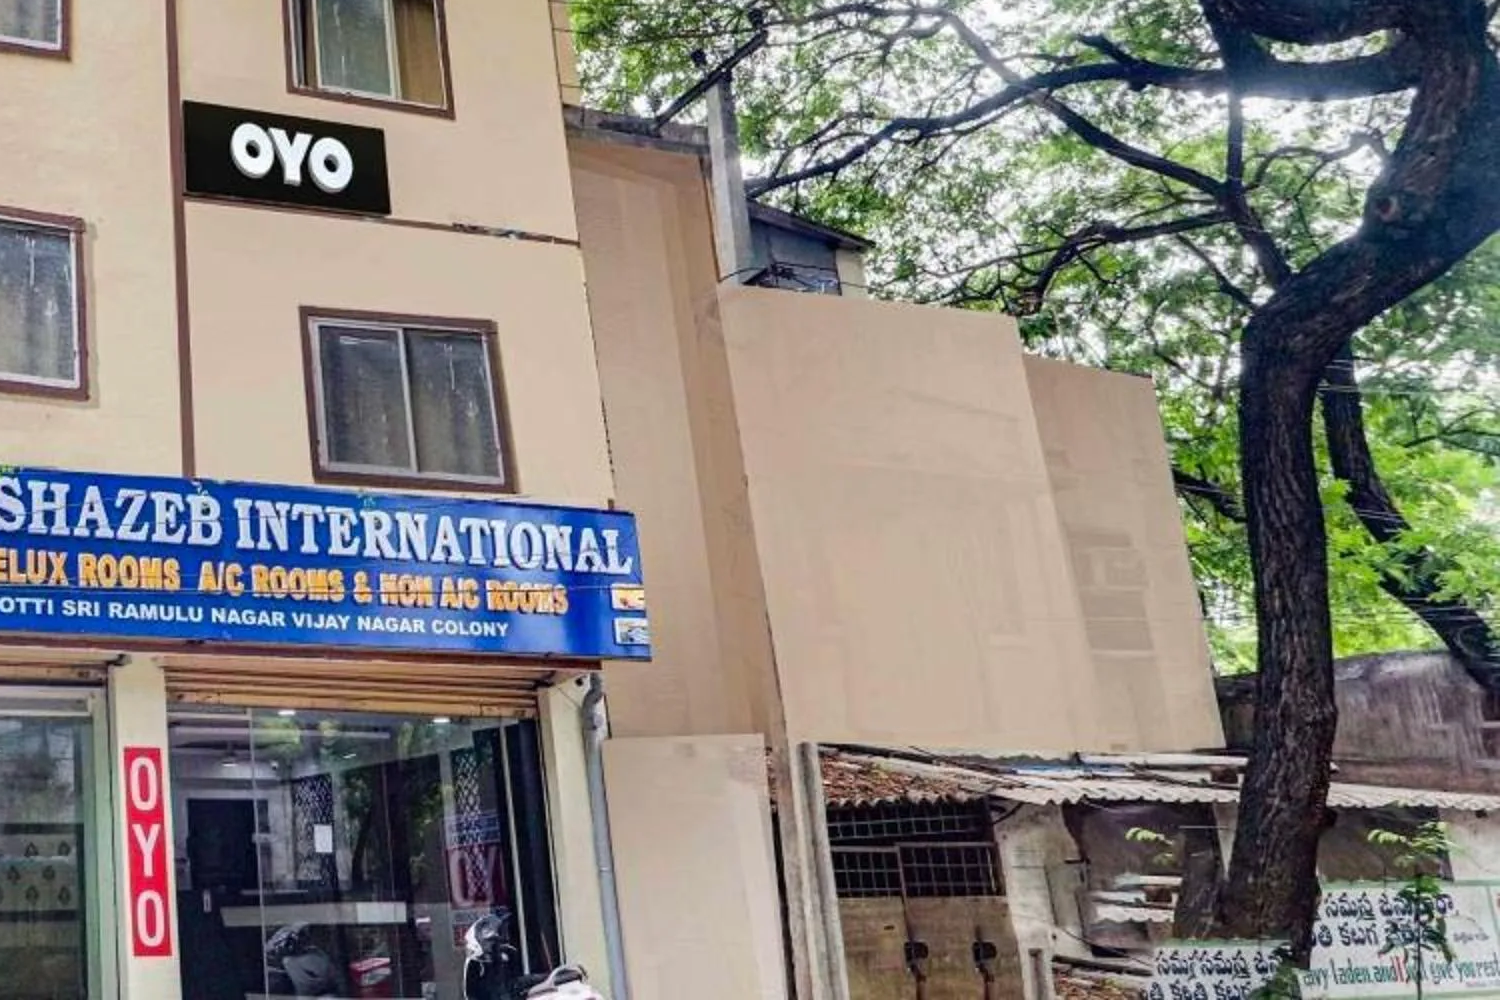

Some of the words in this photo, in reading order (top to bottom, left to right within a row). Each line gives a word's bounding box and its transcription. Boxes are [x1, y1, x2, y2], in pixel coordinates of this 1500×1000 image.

[230, 122, 354, 194] OYO
[233, 497, 633, 575] INTERNATIONAL
[62, 599, 100, 617] SRI
[108, 601, 203, 623] RAMULU
[211, 606, 285, 628] NAGAR
[291, 611, 350, 631] VIJAY
[357, 615, 426, 633] NAGAR
[431, 619, 510, 637] COLONY
[78, 551, 181, 592] ROOMS
[198, 560, 245, 597] A/C
[251, 563, 345, 603] ROOMS
[353, 570, 373, 605] &
[380, 572, 434, 610] NON
[440, 575, 480, 611] A/C
[485, 578, 570, 616] ROOMS
[128, 756, 166, 947] OYO
